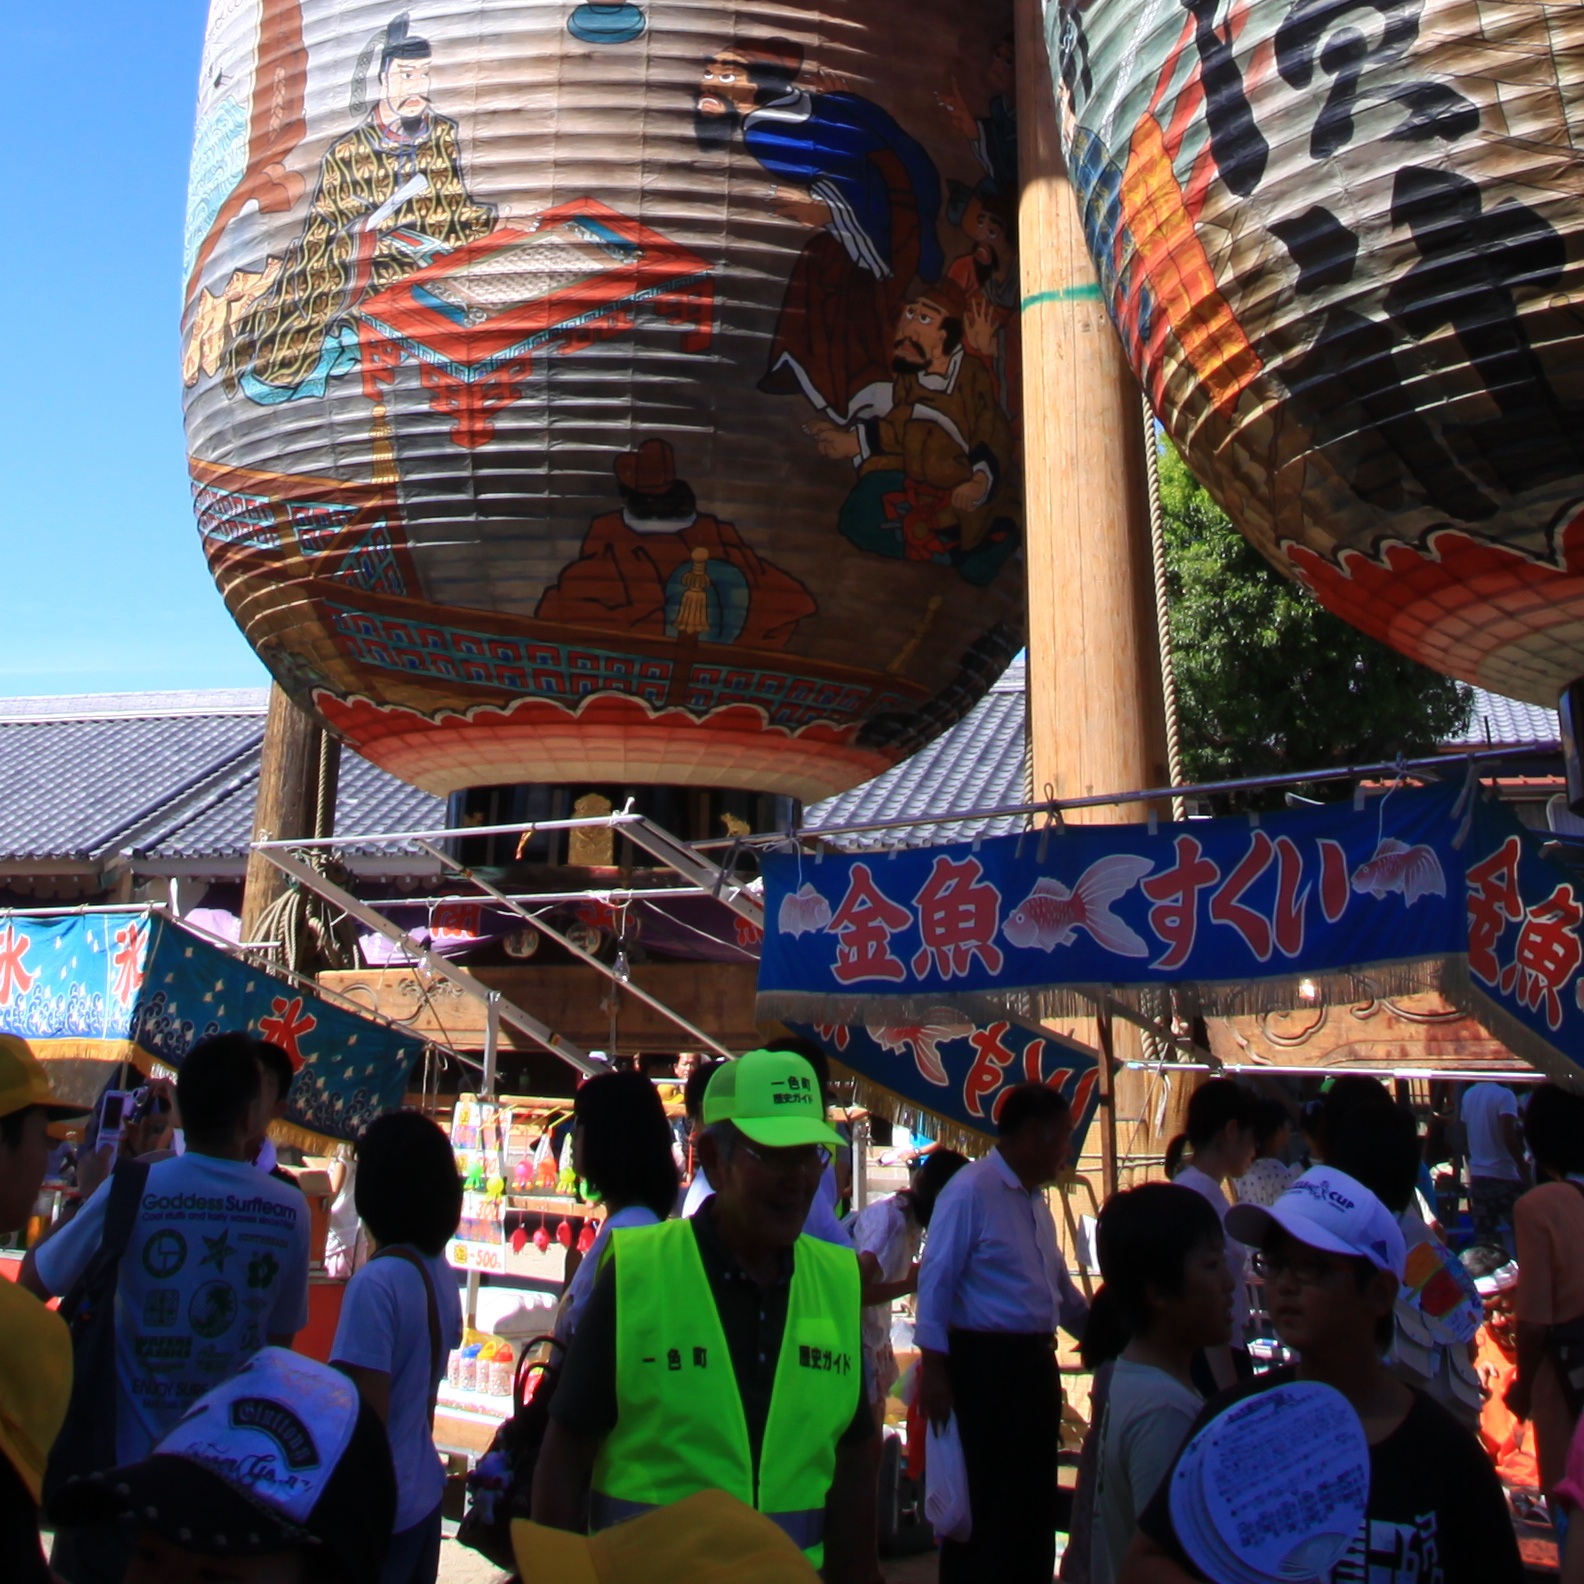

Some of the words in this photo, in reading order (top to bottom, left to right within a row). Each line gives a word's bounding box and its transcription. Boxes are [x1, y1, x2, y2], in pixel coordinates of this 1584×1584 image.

[823, 853, 1003, 985] 金魚
[1140, 829, 1351, 971] すくい
[1465, 835, 1583, 1031] 金魚
[257, 994, 318, 1074] 氷
[771, 1075, 811, 1092] 一色町
[143, 1192, 223, 1212] Goddess
[225, 1194, 297, 1220] Surfteam
[1329, 1191, 1355, 1209] CUP
[642, 1346, 708, 1371] 一色町
[799, 1345, 851, 1376] 歴史ガイド
